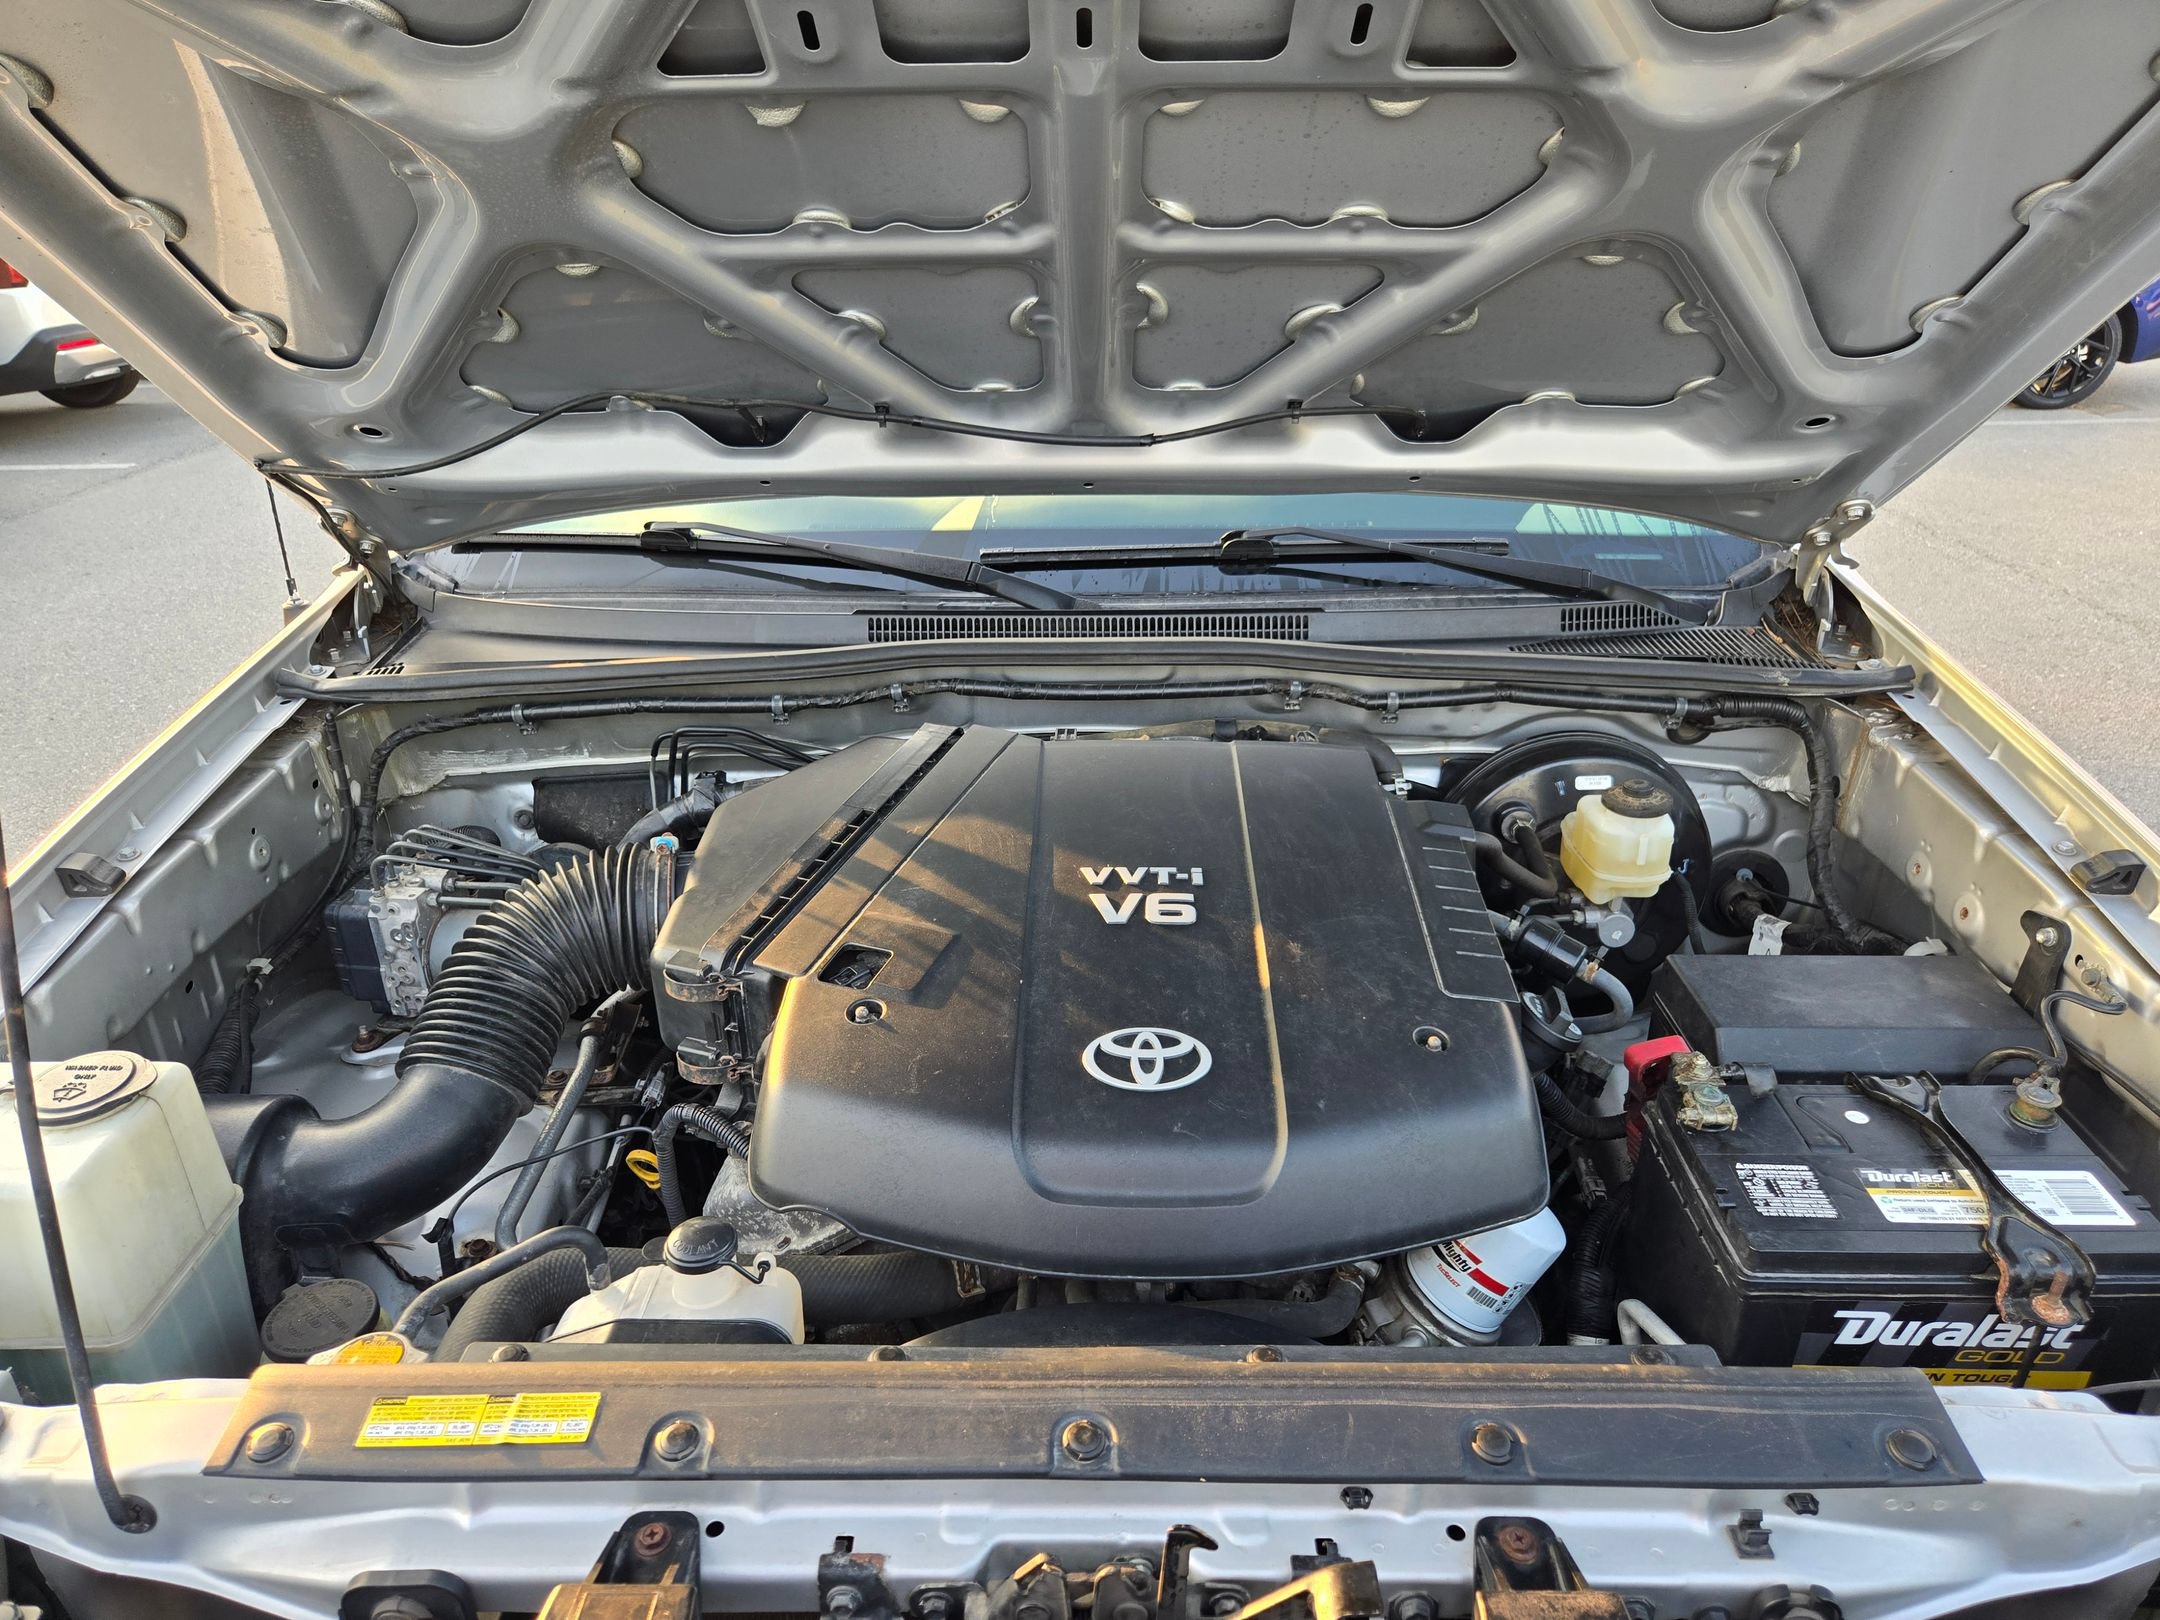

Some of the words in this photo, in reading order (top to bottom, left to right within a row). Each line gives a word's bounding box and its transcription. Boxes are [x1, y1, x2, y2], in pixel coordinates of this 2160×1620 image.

[1079, 866, 1204, 886] VVT-i
[1088, 893, 1197, 926] V6
[1860, 1170, 1953, 1183] Duralast
[1961, 1206, 1985, 1214] 750
[672, 1239, 719, 1255] COOLANT
[1833, 1310, 2086, 1349] Duralast
[1954, 1349, 2066, 1365] GOLD
[1952, 1373, 2030, 1384] TOUG
